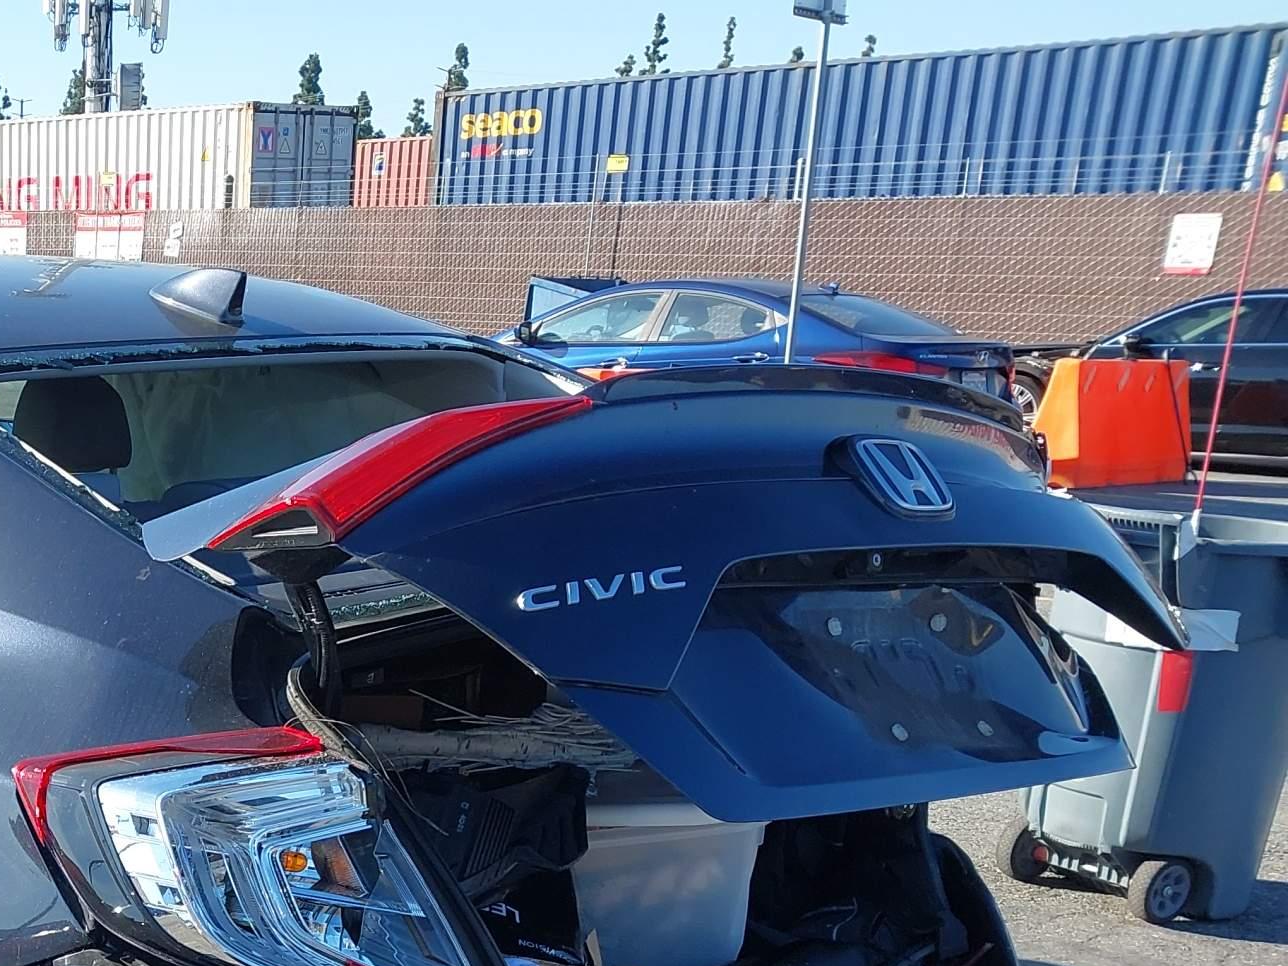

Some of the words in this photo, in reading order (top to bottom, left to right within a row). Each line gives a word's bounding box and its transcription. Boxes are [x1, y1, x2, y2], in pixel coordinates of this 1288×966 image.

[461, 108, 542, 139] seaco
[53, 173, 153, 210] MING
[516, 565, 687, 612] CIVIC
